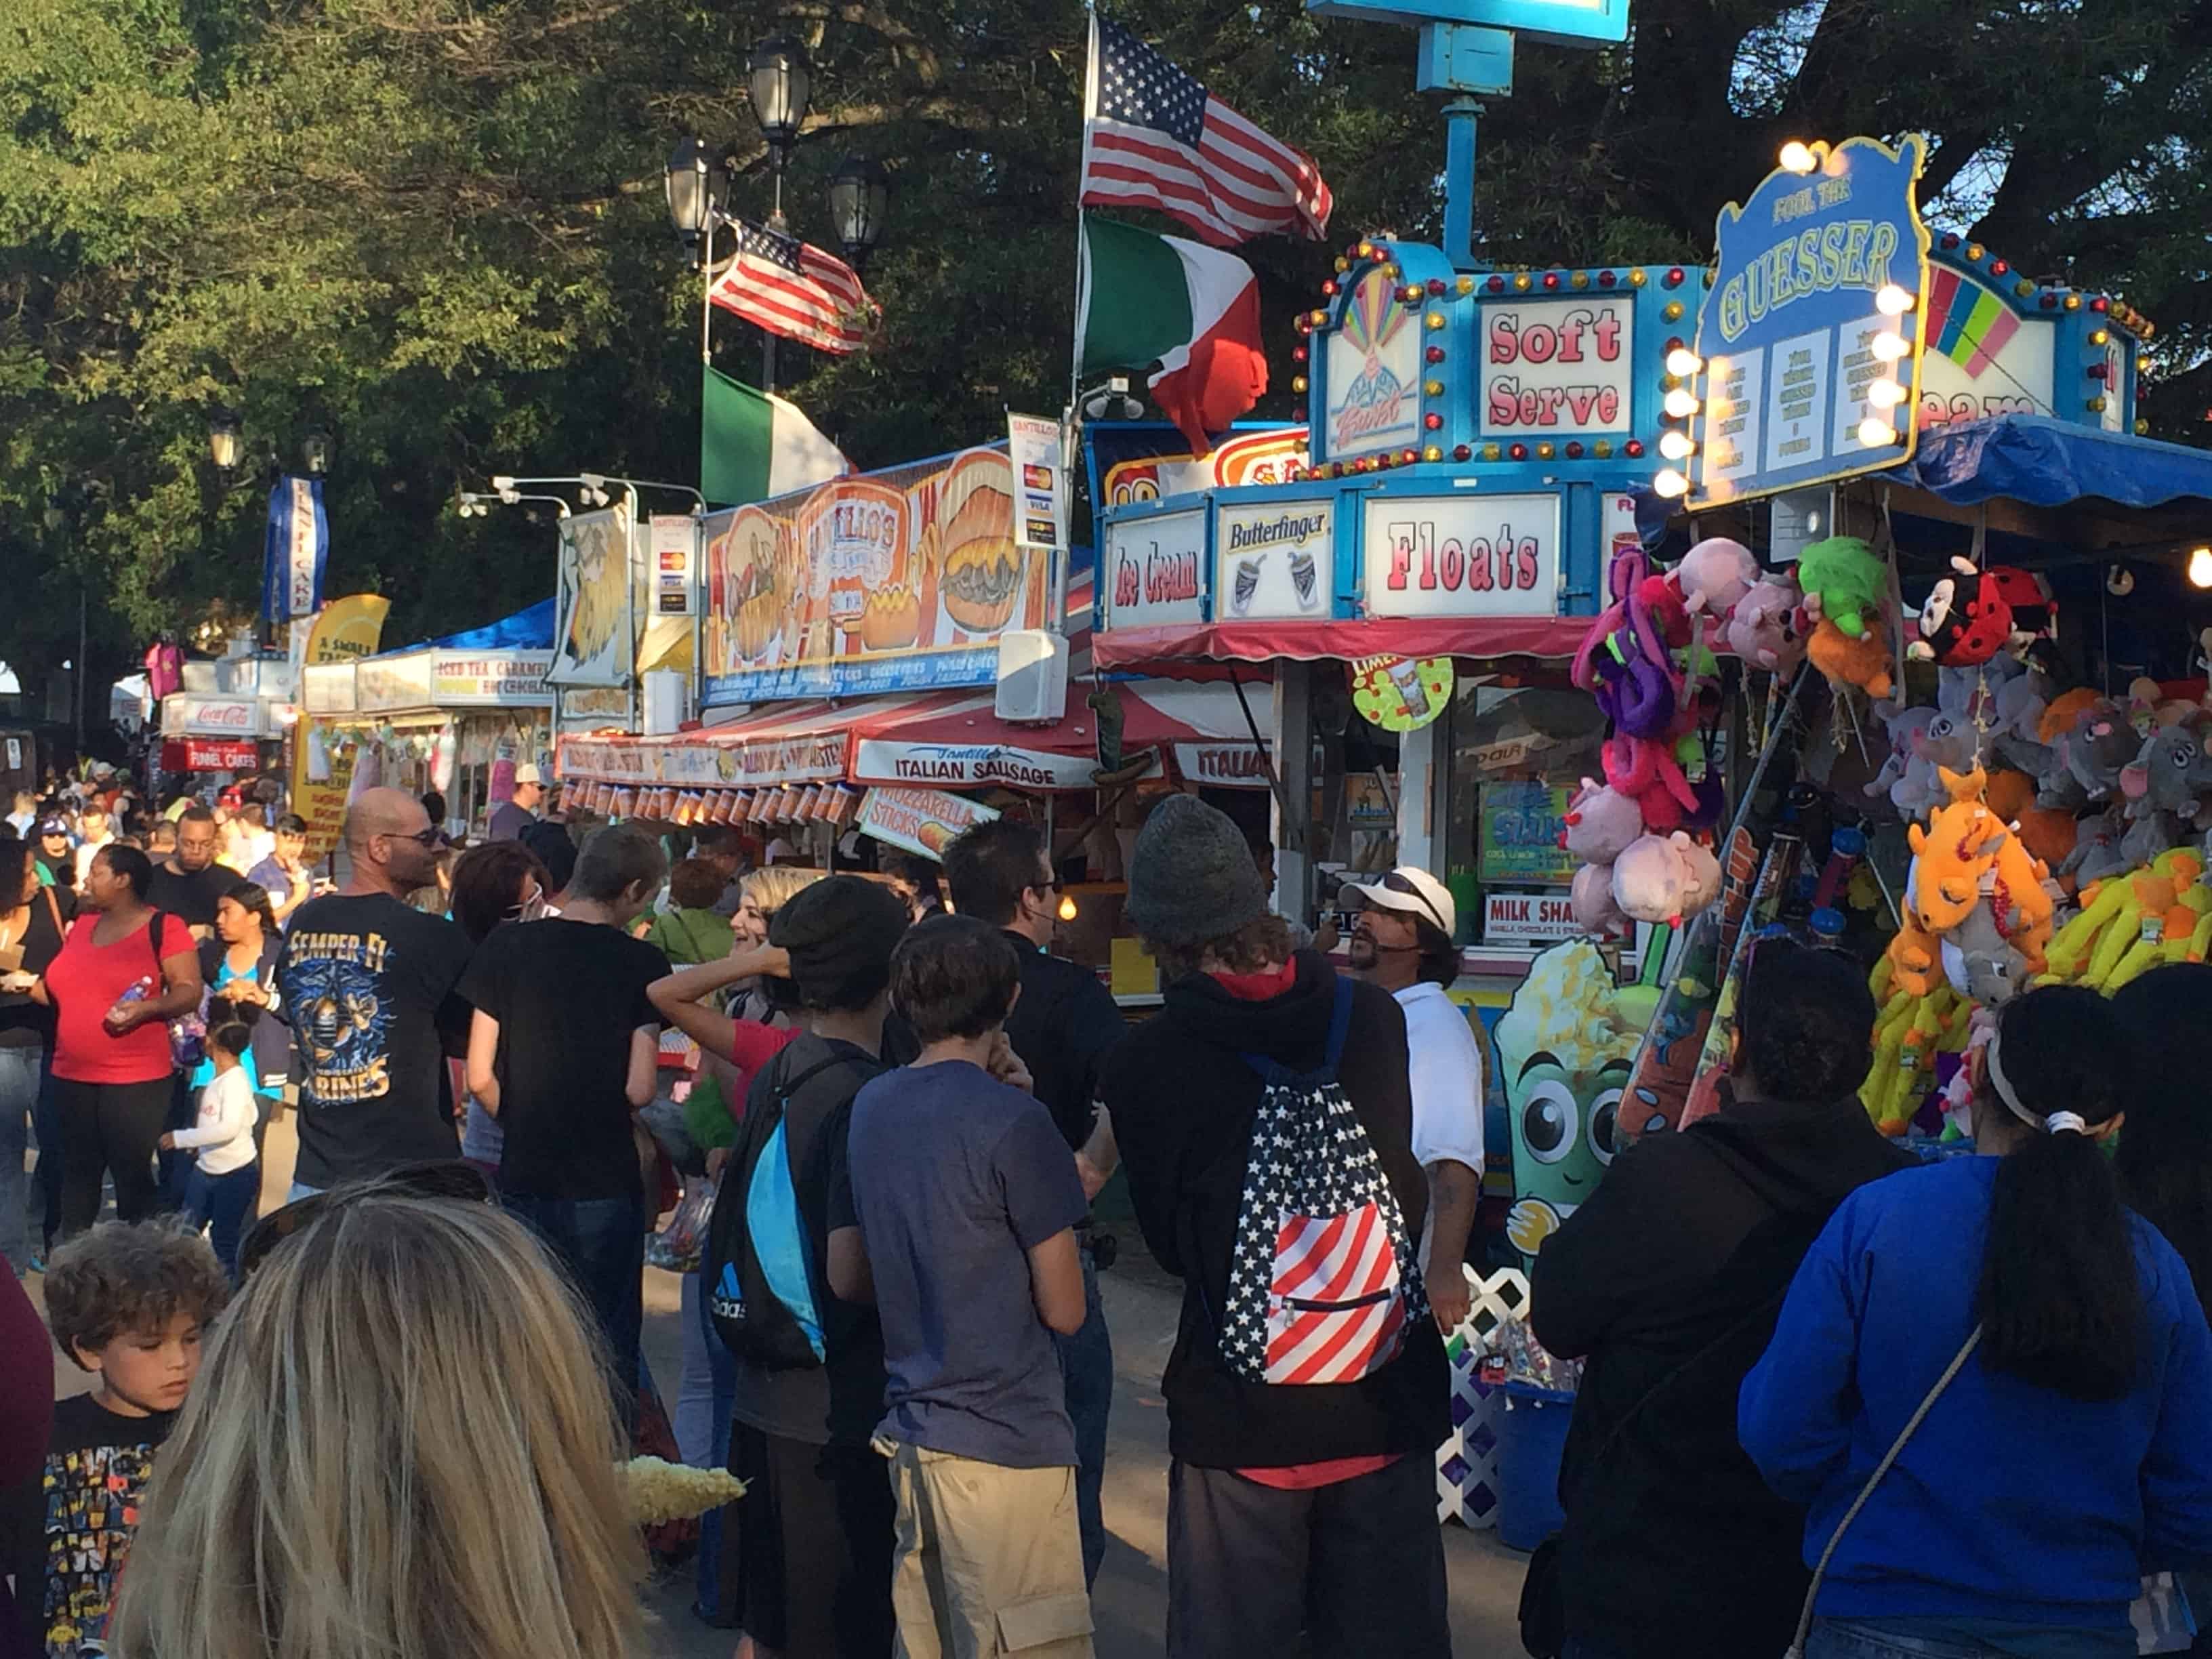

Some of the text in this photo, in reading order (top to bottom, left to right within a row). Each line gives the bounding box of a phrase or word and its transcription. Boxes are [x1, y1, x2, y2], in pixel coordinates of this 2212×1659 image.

[1719, 220, 1899, 343] GUESSER
[1490, 308, 1620, 365] Soft
[1488, 375, 1619, 426] Serve
[1229, 513, 1326, 550] Butterfinger
[1144, 541, 1197, 605] Cream
[1388, 521, 1538, 591] Floats
[226, 753, 256, 769] CAKES
[895, 759, 1056, 785] ITALIAN SAUSAGE
[1197, 750, 1272, 778] ITALIA
[870, 800, 920, 838] STICKS
[1491, 899, 1578, 923] MILK SHA
[288, 930, 361, 968] SEMPER
[314, 1057, 391, 1101] RINES
